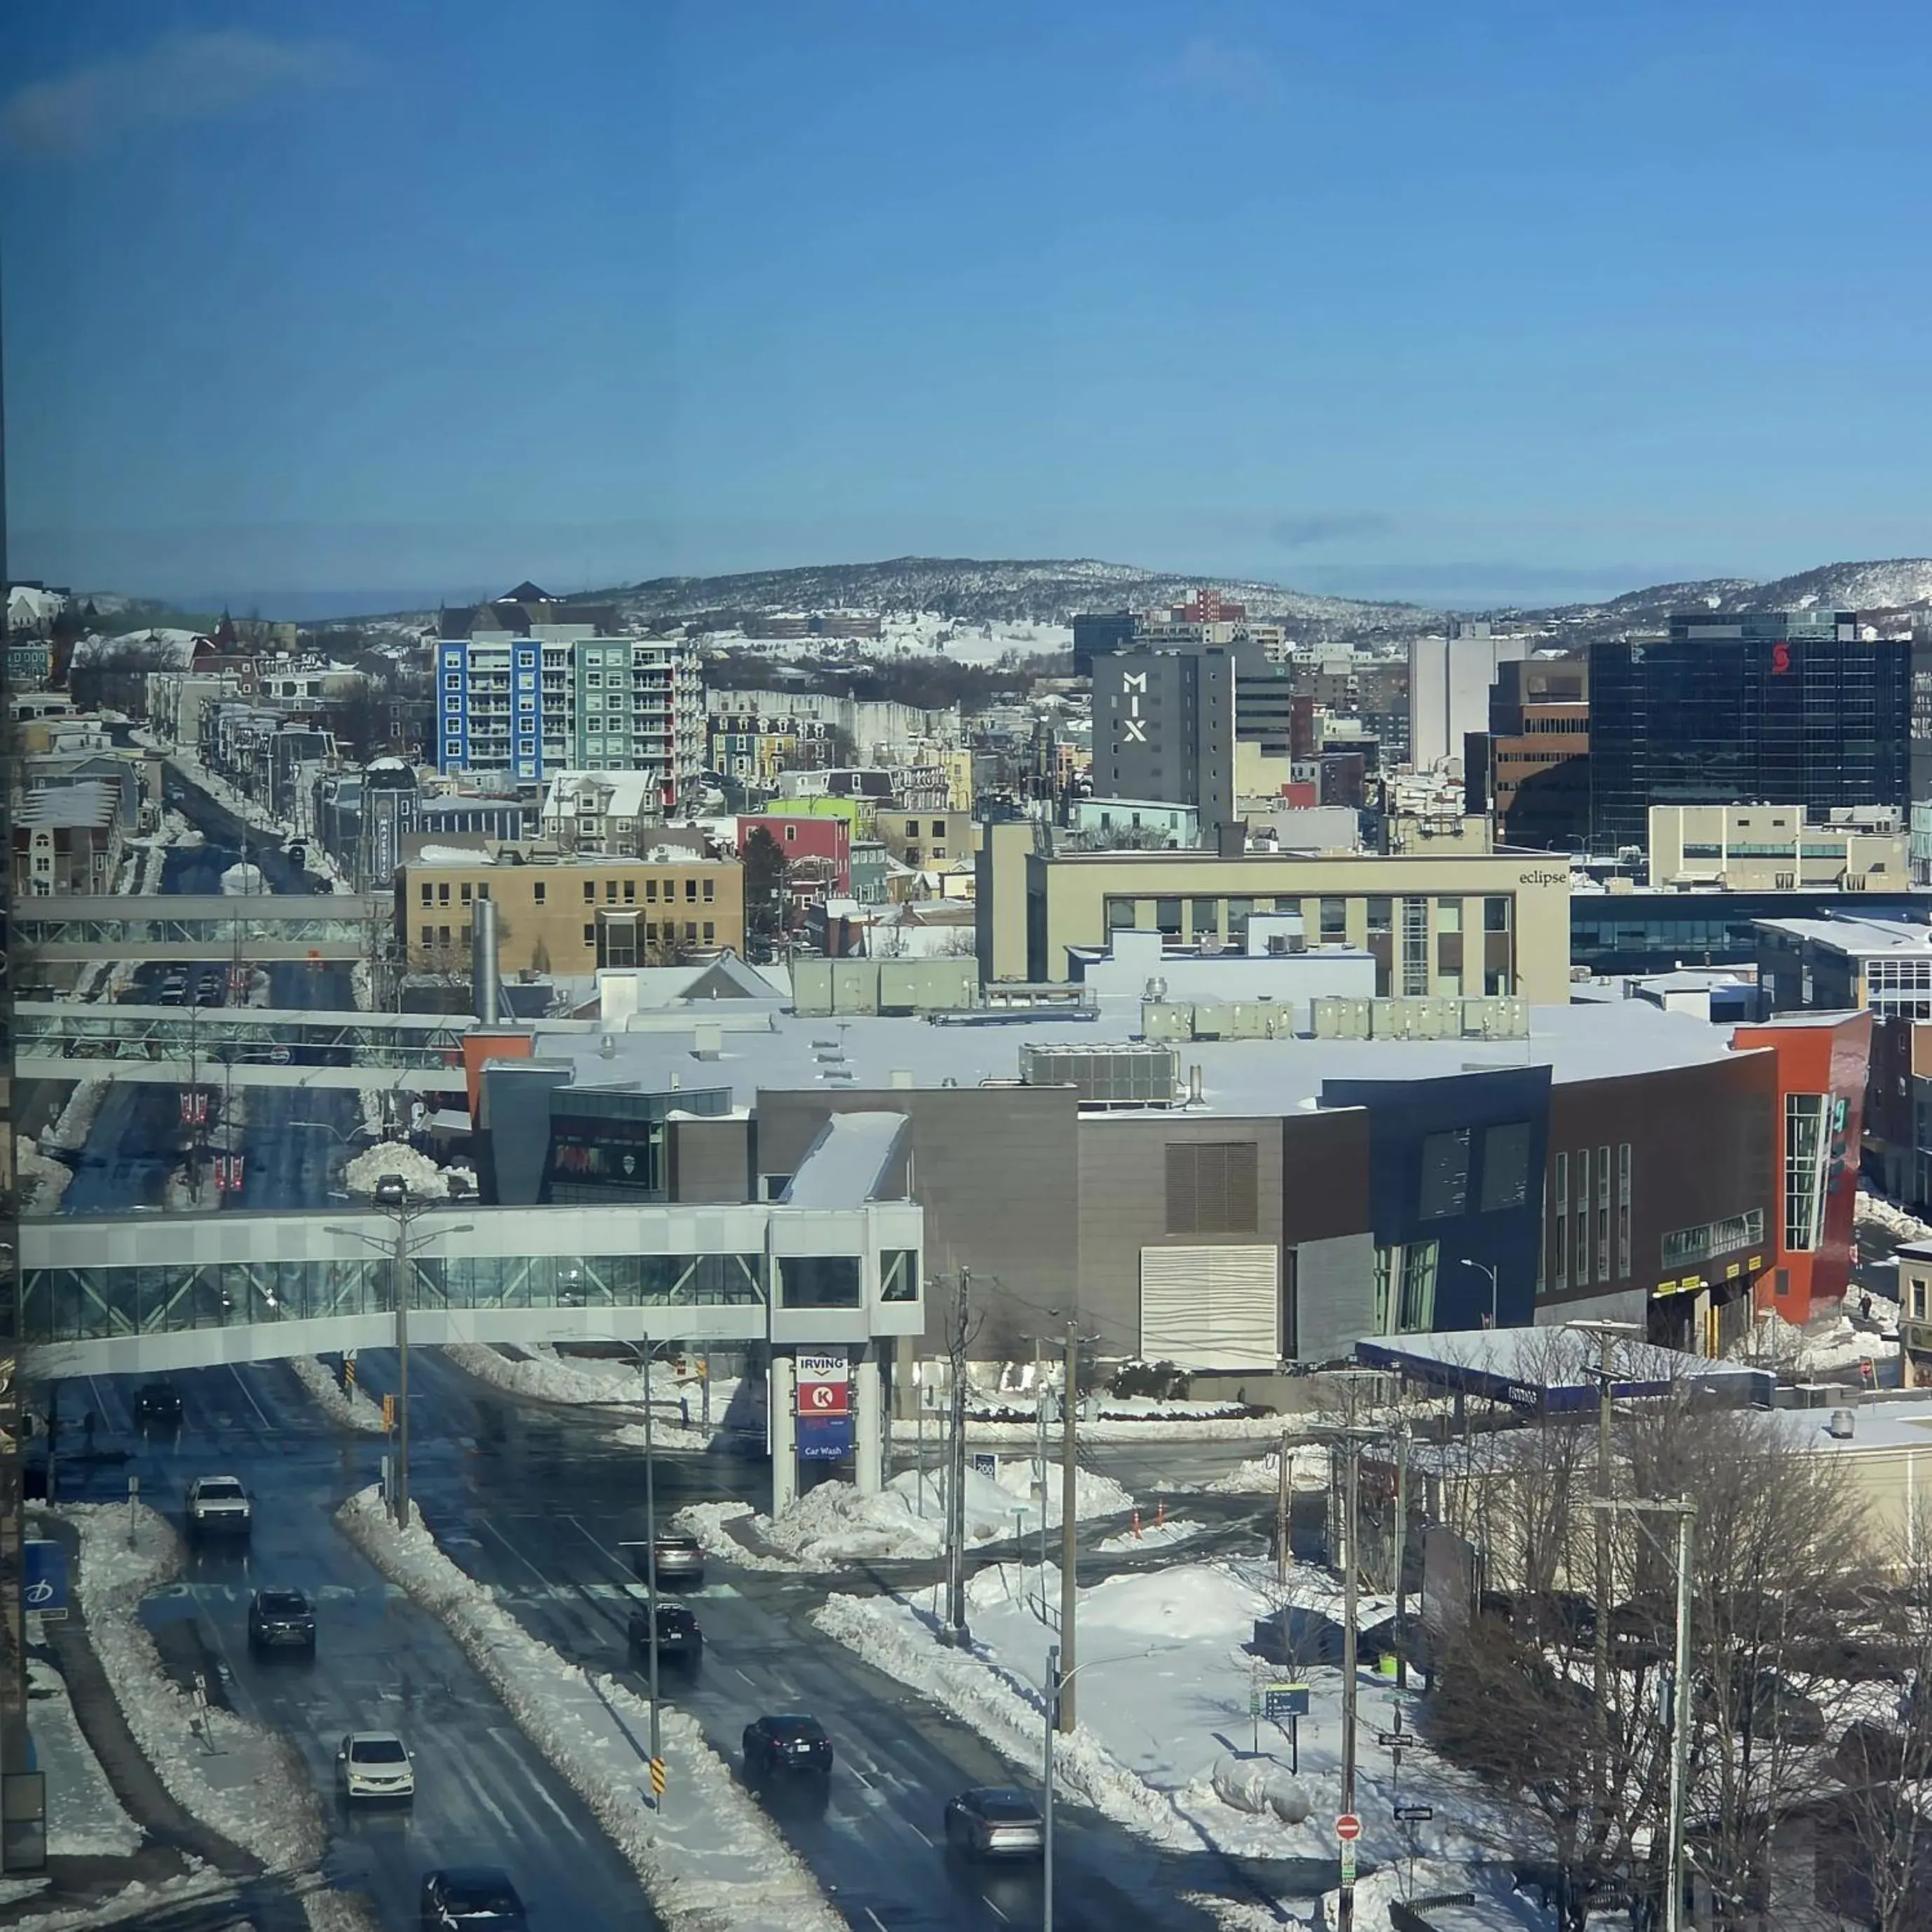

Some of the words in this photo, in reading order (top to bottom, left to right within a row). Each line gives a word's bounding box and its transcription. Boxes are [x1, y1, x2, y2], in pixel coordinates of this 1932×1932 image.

[1123, 671, 1146, 741] MIX
[1519, 870, 1567, 888] eclipse
[800, 1358, 843, 1369] IRVING
[817, 1390, 830, 1407] K
[804, 1447, 818, 1455] Car
[821, 1446, 842, 1455] Wash
